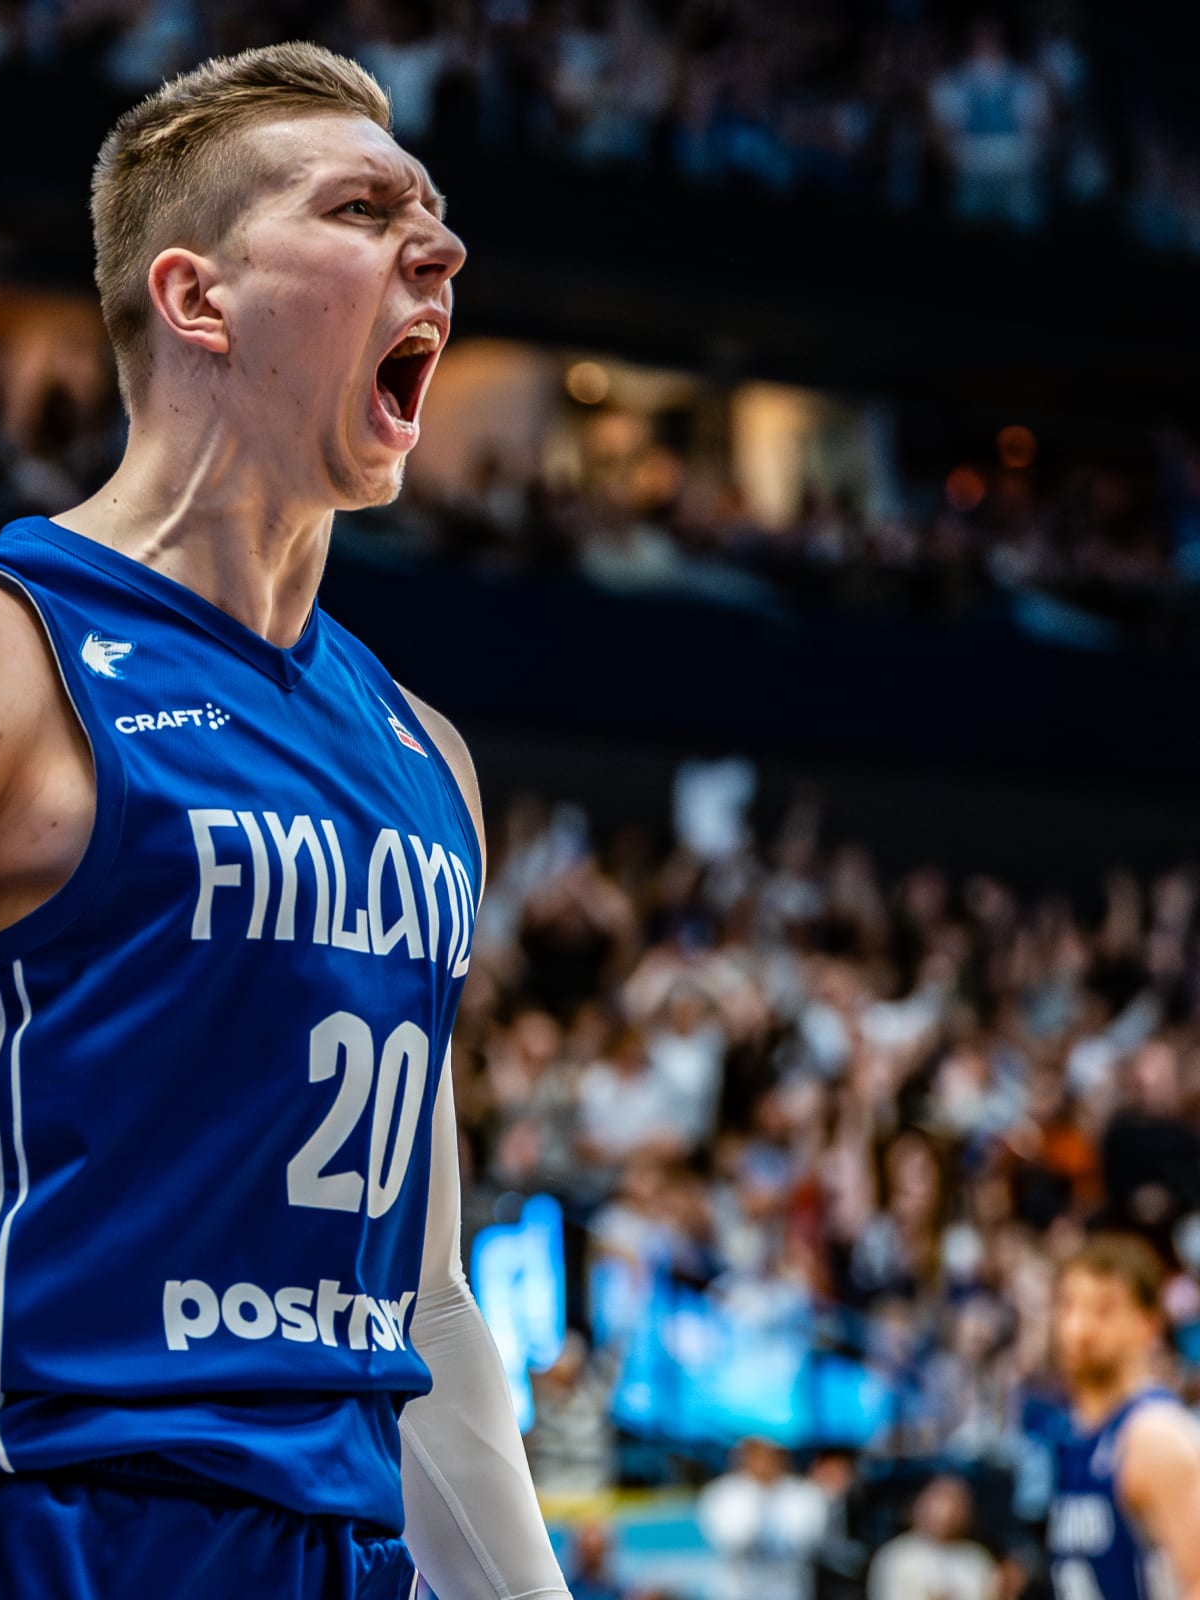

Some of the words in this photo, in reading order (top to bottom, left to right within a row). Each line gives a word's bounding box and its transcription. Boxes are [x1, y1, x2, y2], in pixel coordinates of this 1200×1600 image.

[115, 709, 203, 734] CRAFT
[188, 808, 475, 979] FINLAND
[287, 1010, 429, 1219] 20
